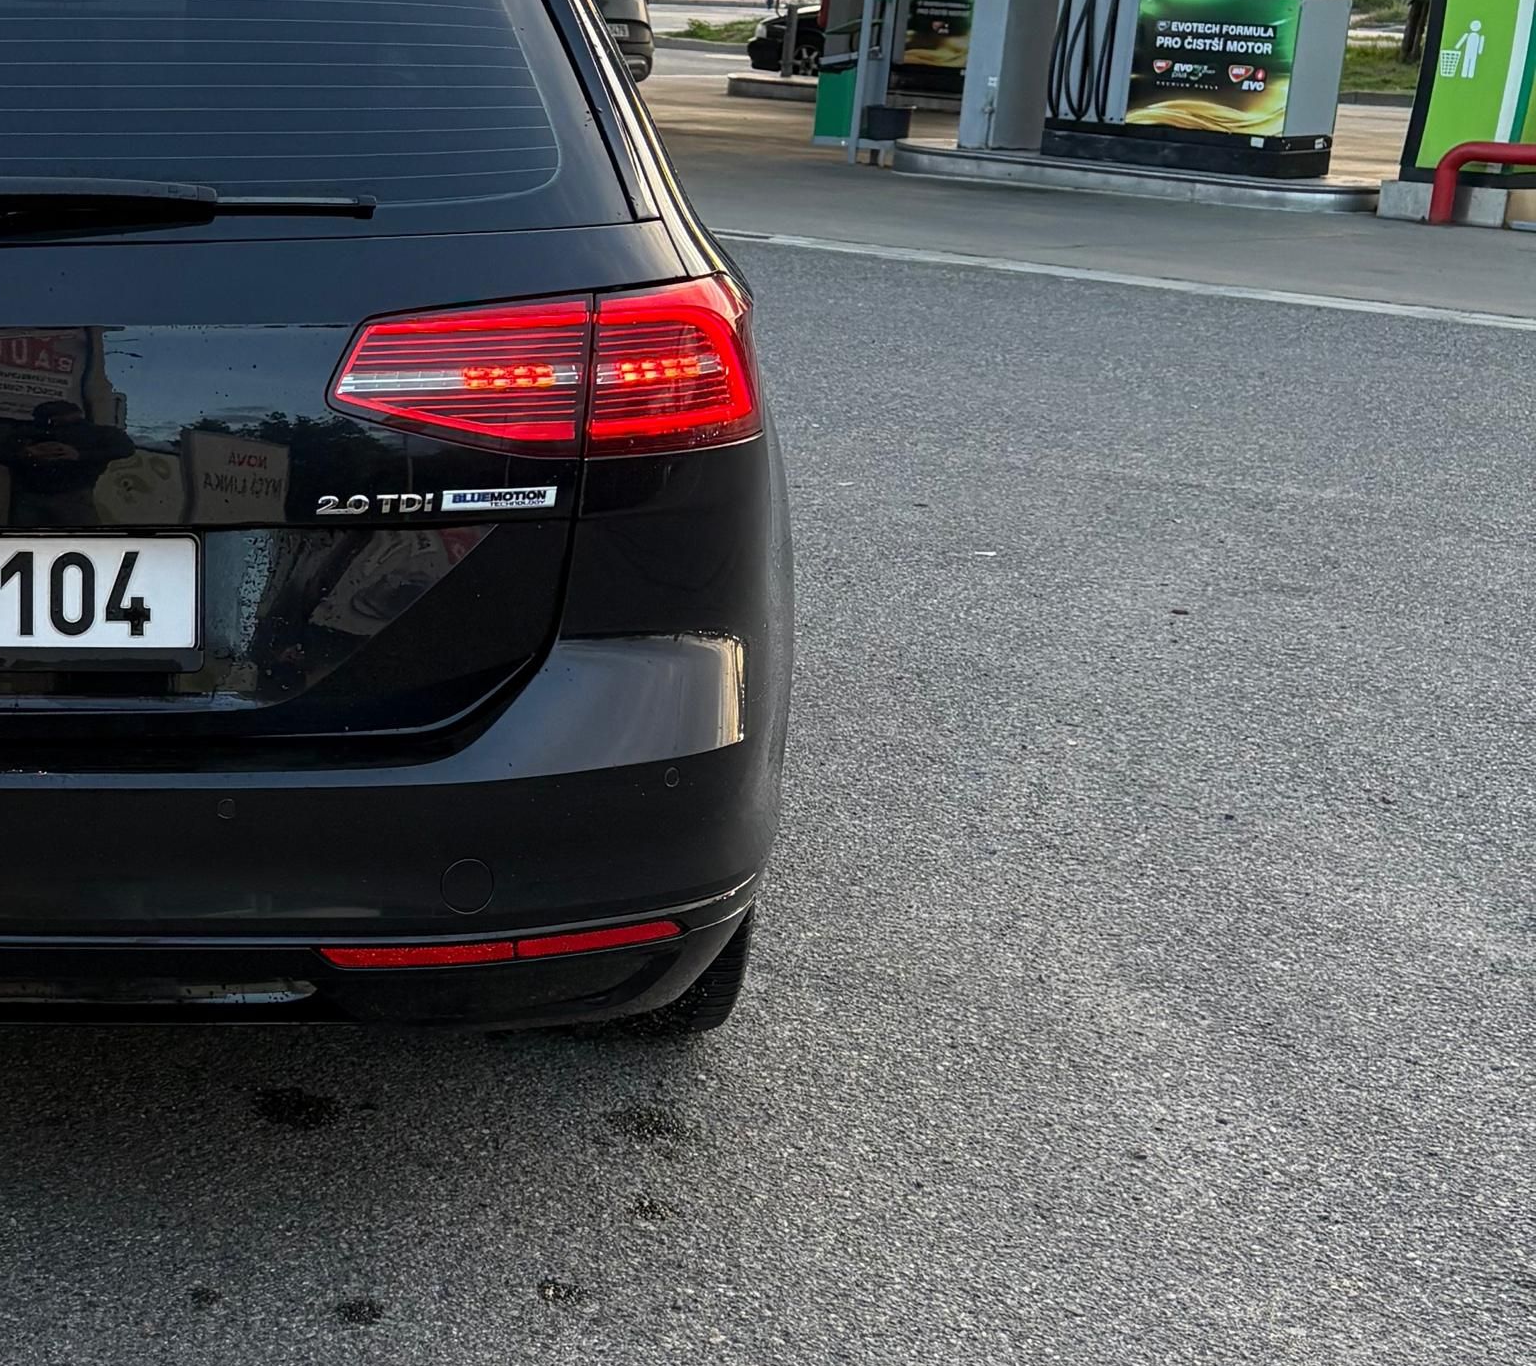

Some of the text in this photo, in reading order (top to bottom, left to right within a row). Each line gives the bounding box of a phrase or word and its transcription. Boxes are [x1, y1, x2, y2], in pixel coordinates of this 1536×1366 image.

[1171, 21, 1275, 38] EVOTECH FORMULA
[1156, 35, 1273, 55] PRO ČISTŠÍ MOTOR
[1241, 80, 1266, 92] EVO
[316, 489, 547, 515] 2.0 TDI BLUEMOTION
[489, 498, 546, 508] TECHNOLOGY
